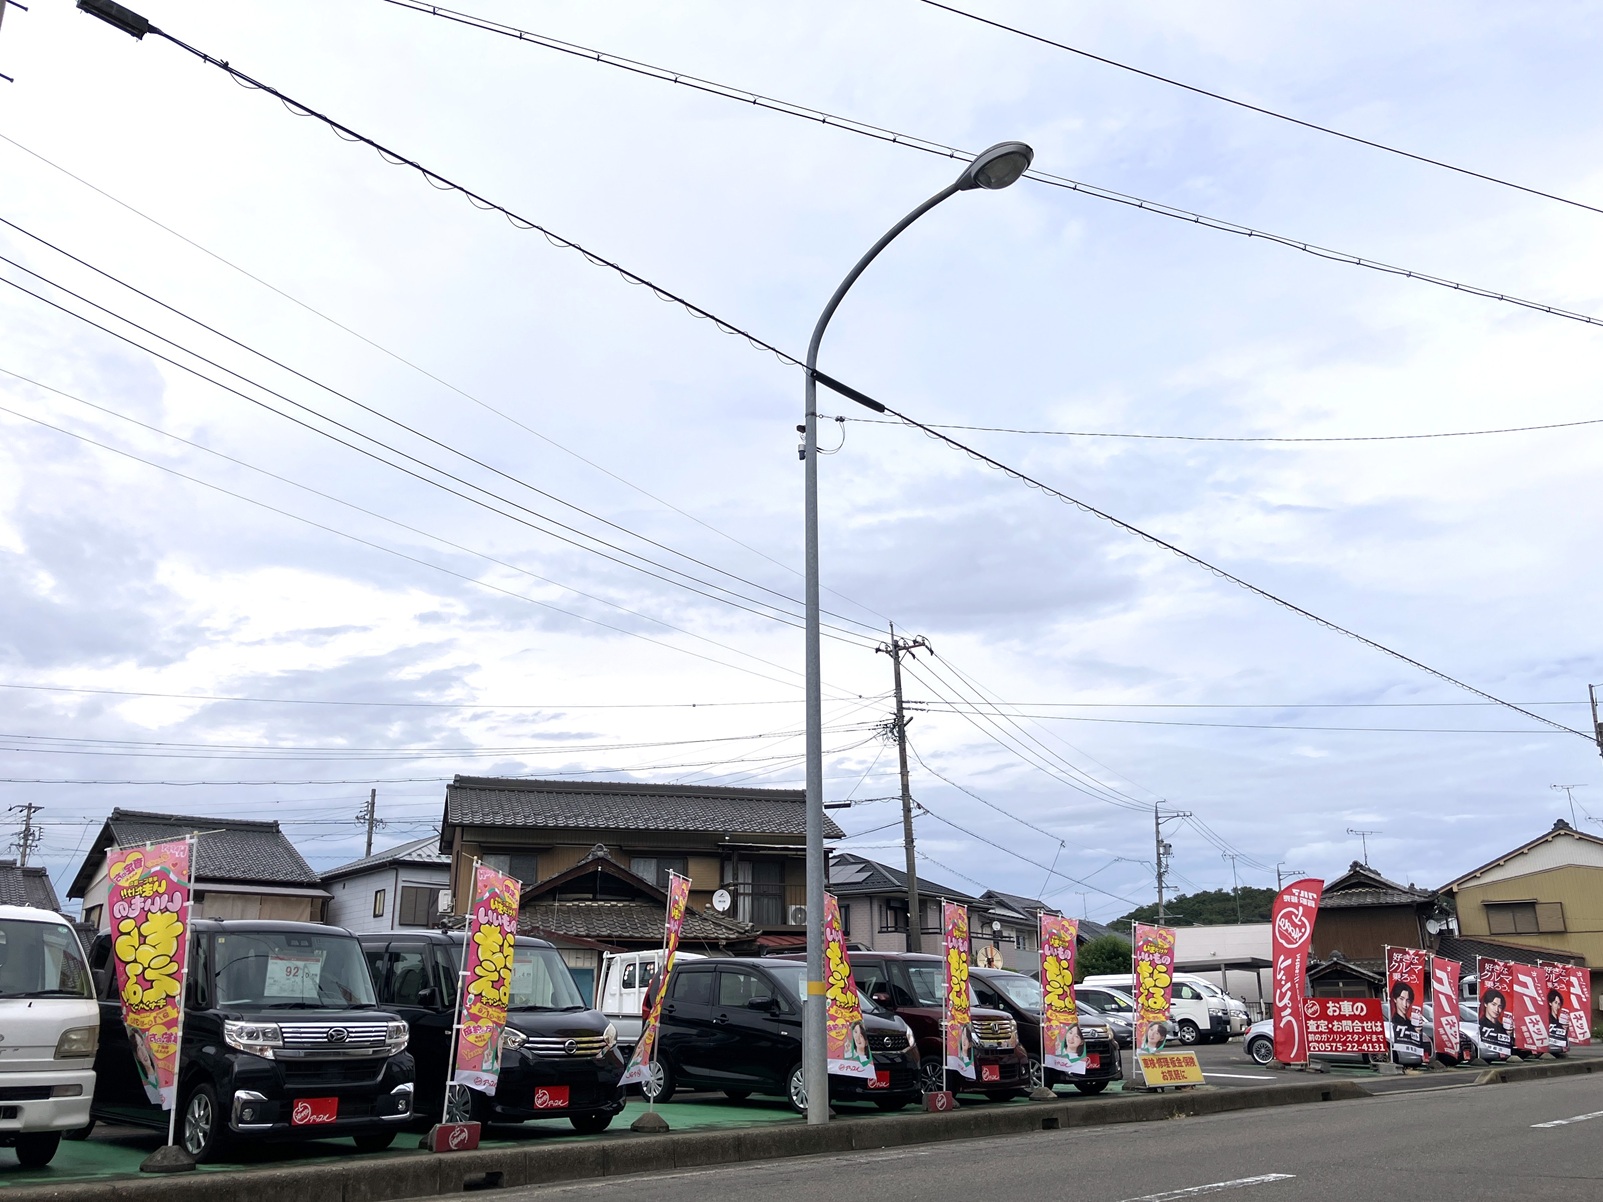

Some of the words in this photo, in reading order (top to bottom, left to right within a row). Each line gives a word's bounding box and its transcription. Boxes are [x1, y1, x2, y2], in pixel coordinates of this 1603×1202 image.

[1393, 953, 1419, 964] 好きな
[1389, 961, 1422, 974] クルマ
[1485, 963, 1508, 974] 好きな
[1481, 971, 1512, 983] クルマ
[1326, 1001, 1367, 1017] お車の
[1306, 1020, 1383, 1032] 査定・お問合せは
[1308, 1033, 1384, 1042] 前のガソリンスタンドまで
[1319, 1043, 1386, 1051] 0575-22-4131
